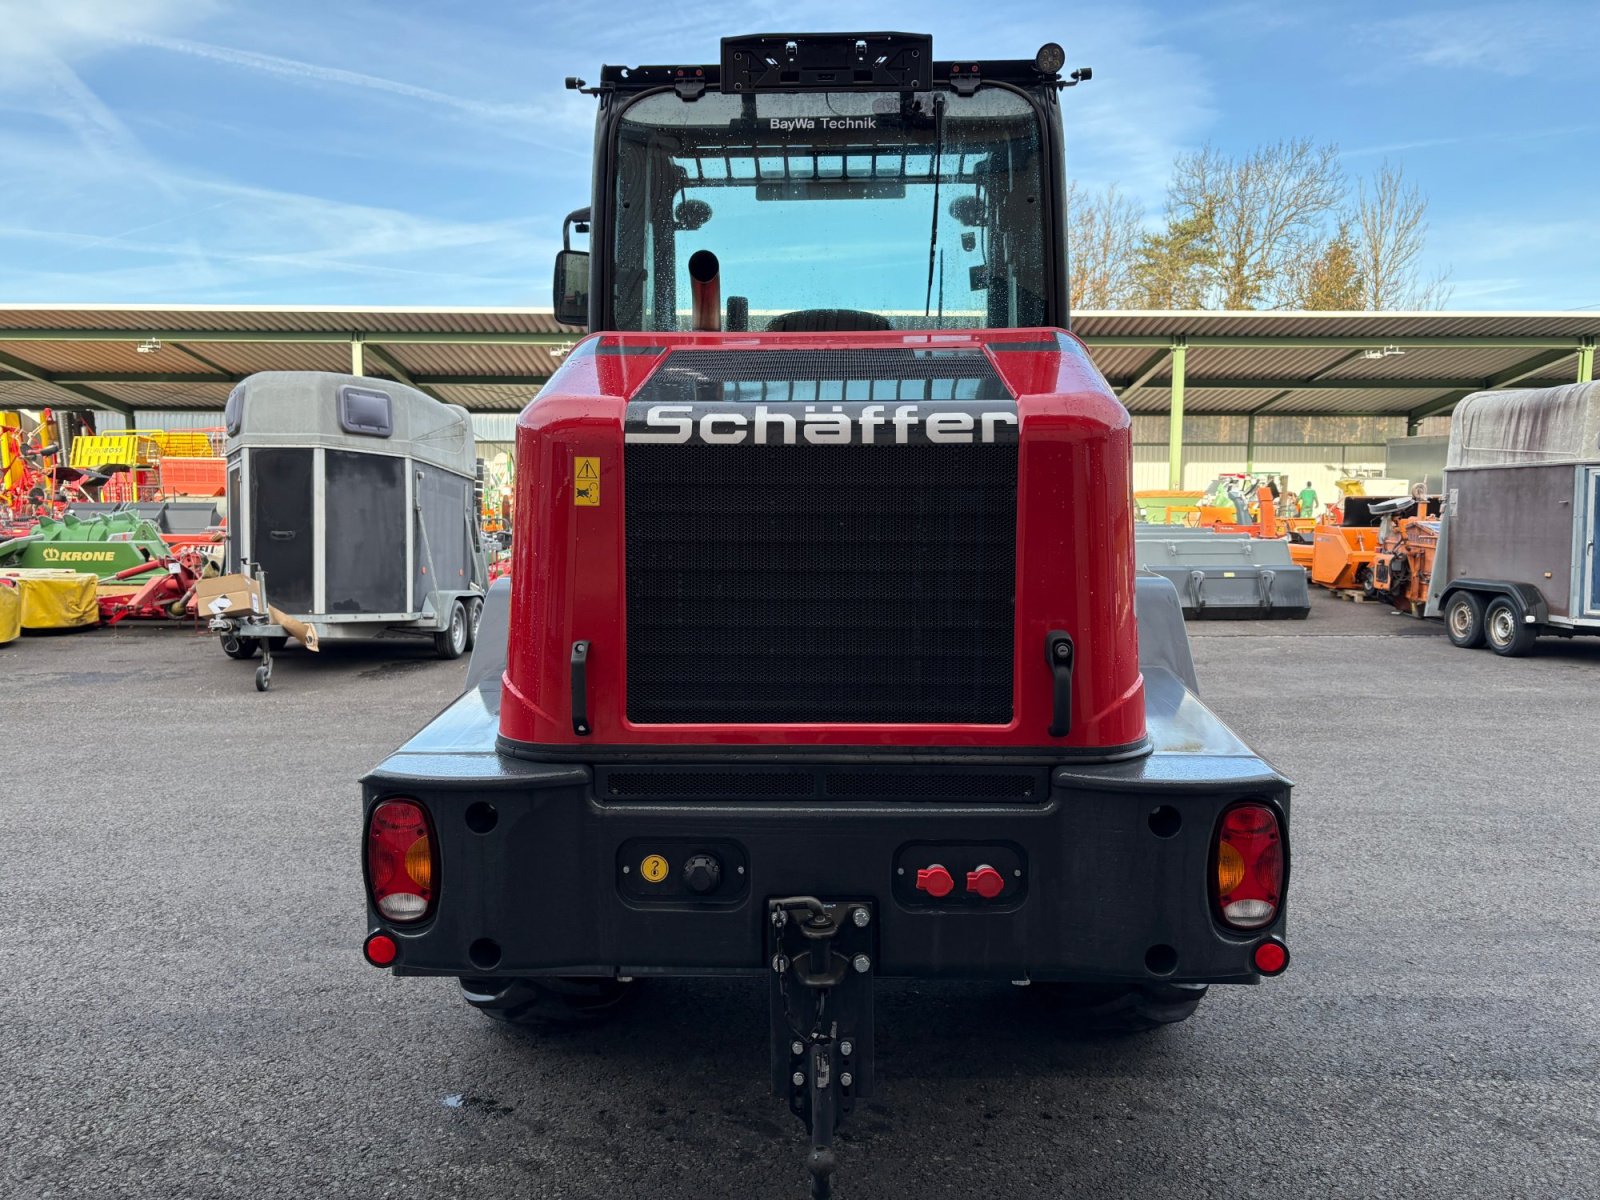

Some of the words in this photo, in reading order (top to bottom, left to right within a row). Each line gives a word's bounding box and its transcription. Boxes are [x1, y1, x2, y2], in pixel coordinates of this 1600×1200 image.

[770, 118, 815, 131] BayWa
[820, 117, 876, 129] Technik
[624, 405, 1018, 444] Schäffer
[60, 551, 115, 561] KRONE
